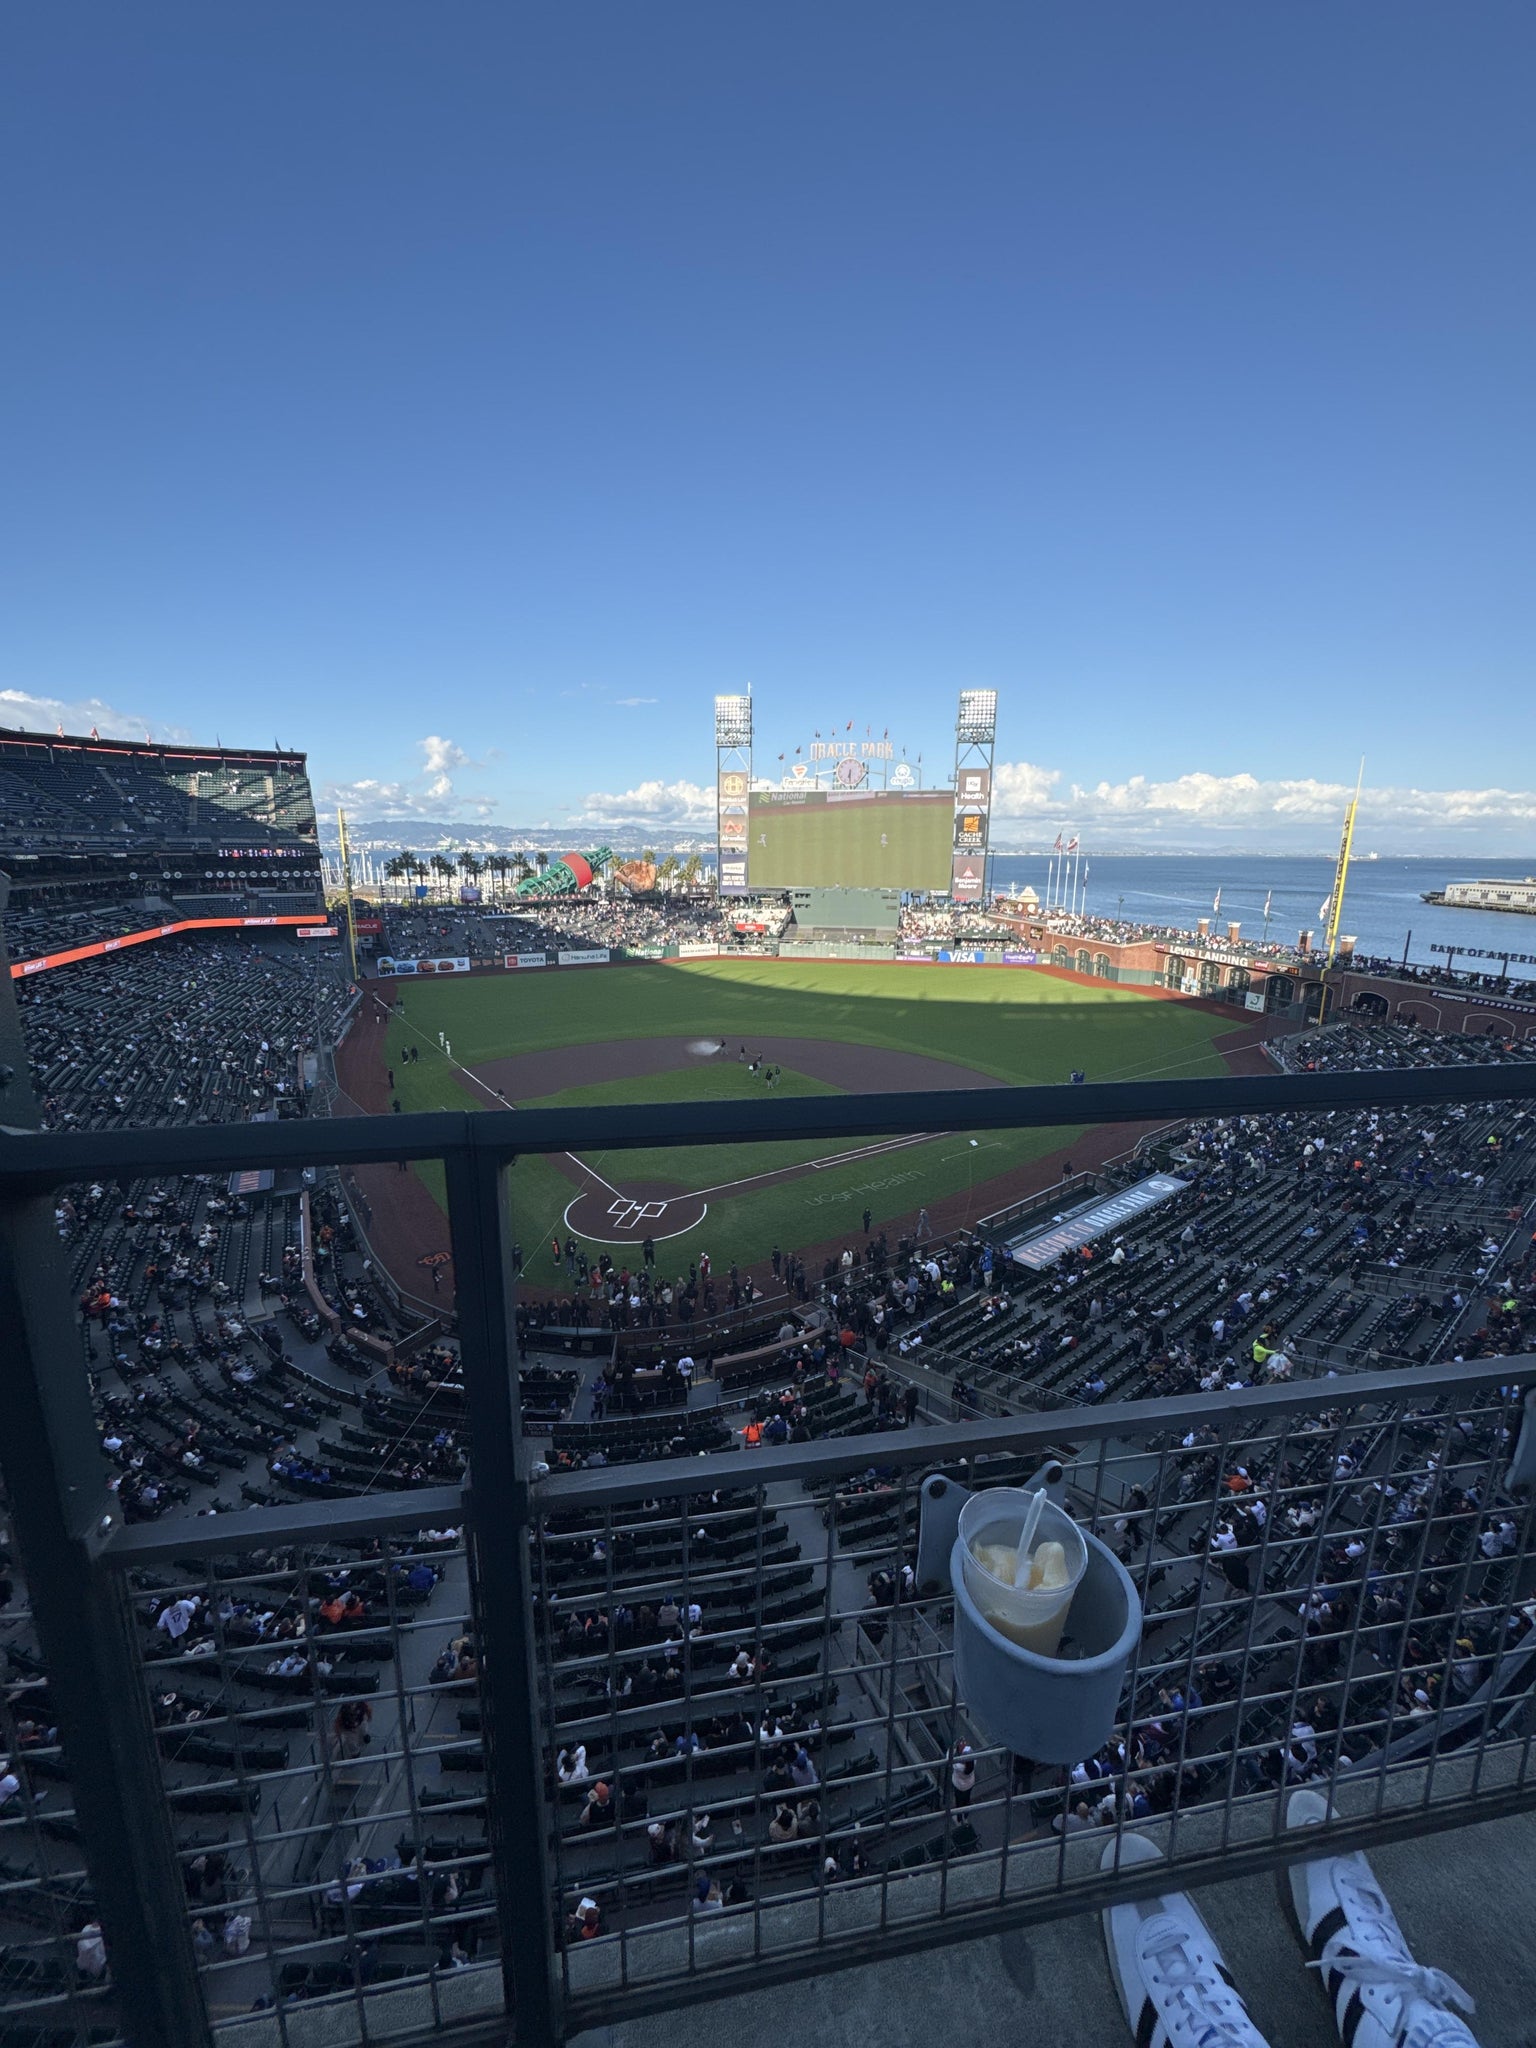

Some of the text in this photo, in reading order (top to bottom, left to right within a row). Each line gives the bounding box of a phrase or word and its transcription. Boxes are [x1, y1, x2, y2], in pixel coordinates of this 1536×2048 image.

[810, 742, 894, 760] ORACLE PARK
[960, 792, 985, 800] Health
[954, 877, 982, 885] Benjamin
[1430, 943, 1465, 955] BANK
[1467, 948, 1485, 957] OF
[519, 956, 545, 964] TOYOTA
[949, 952, 976, 963] VISA
[1198, 949, 1249, 967] LANDING
[851, 1169, 926, 1196] Health
[1016, 1189, 1156, 1264] WELCOME TO ORACLE PARK
